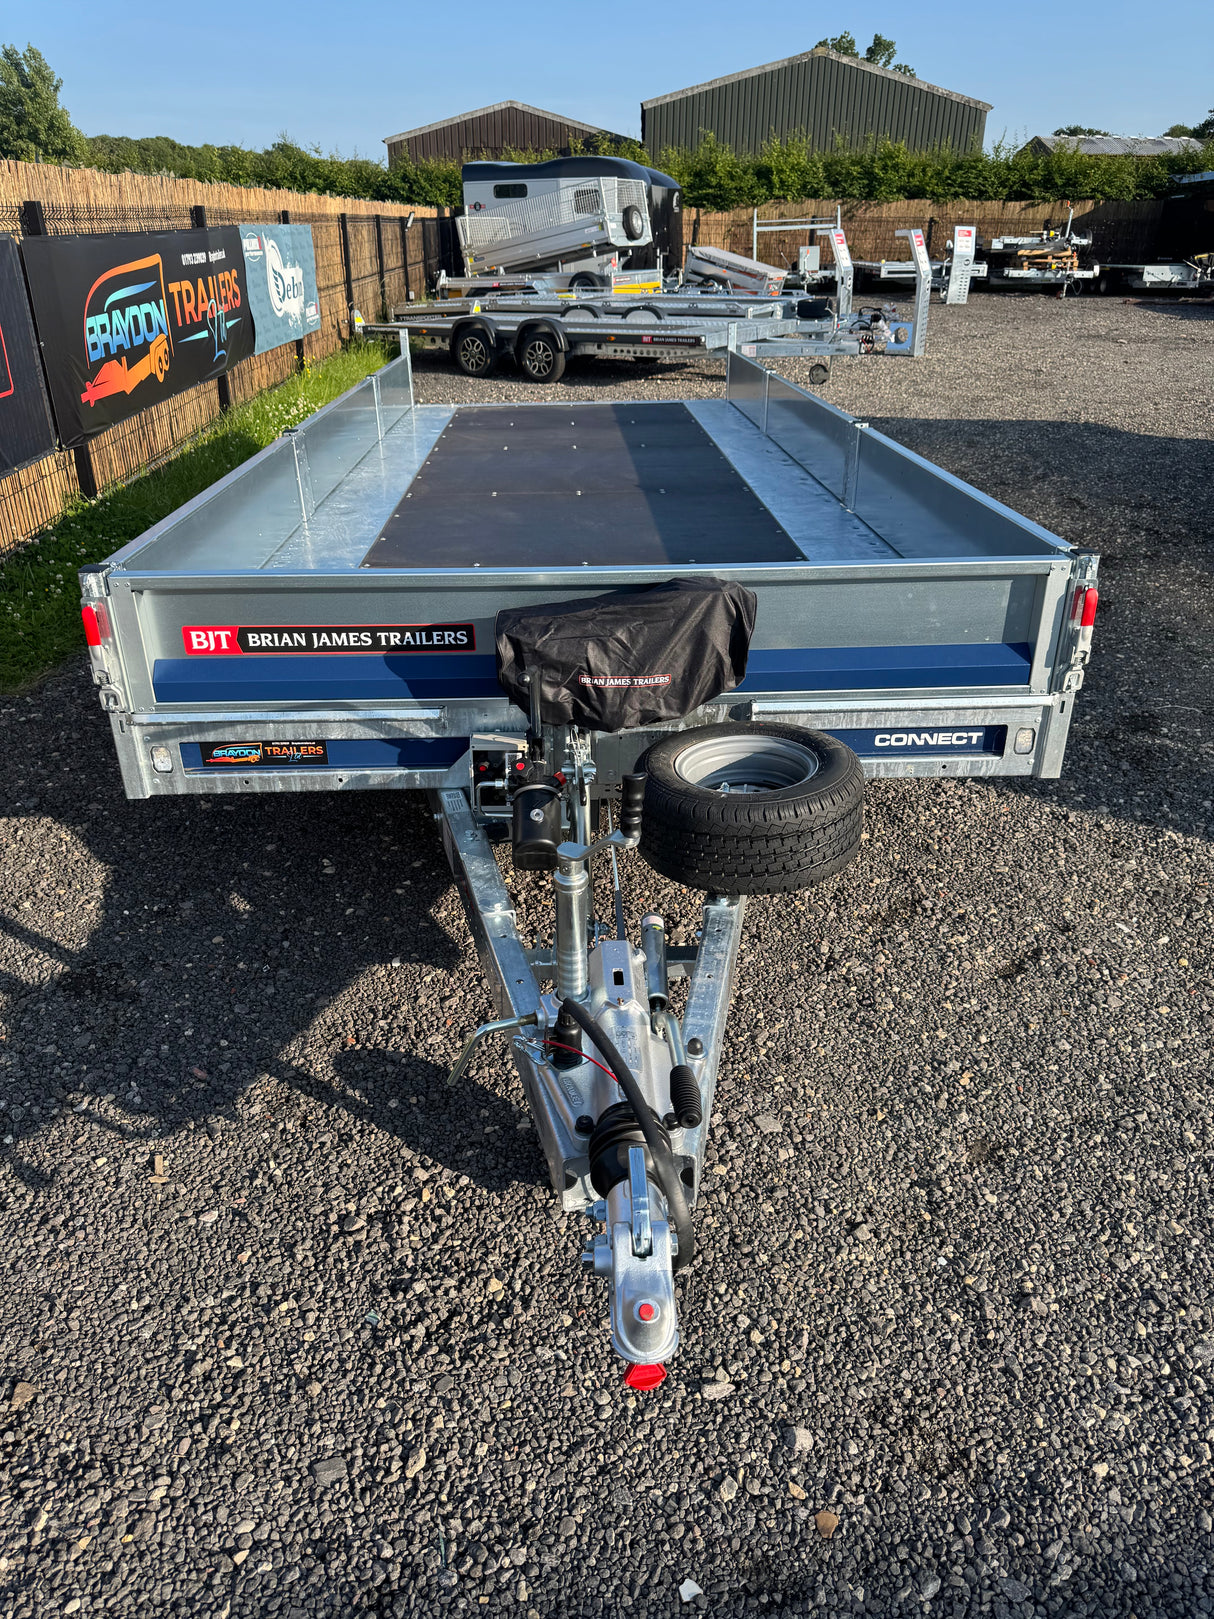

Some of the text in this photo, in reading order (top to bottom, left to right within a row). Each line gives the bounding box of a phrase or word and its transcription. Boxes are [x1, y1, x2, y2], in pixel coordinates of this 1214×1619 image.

[168, 268, 241, 327] TRAILERS
[86, 299, 168, 362] BRAYDON
[189, 630, 468, 651] BJT BRIAN JAMES TRAILERS
[580, 675, 669, 686] BRIAN JAMES TRAILERS
[874, 732, 984, 747] CONNECT
[213, 746, 324, 758] BRAYDON TRAILERS
